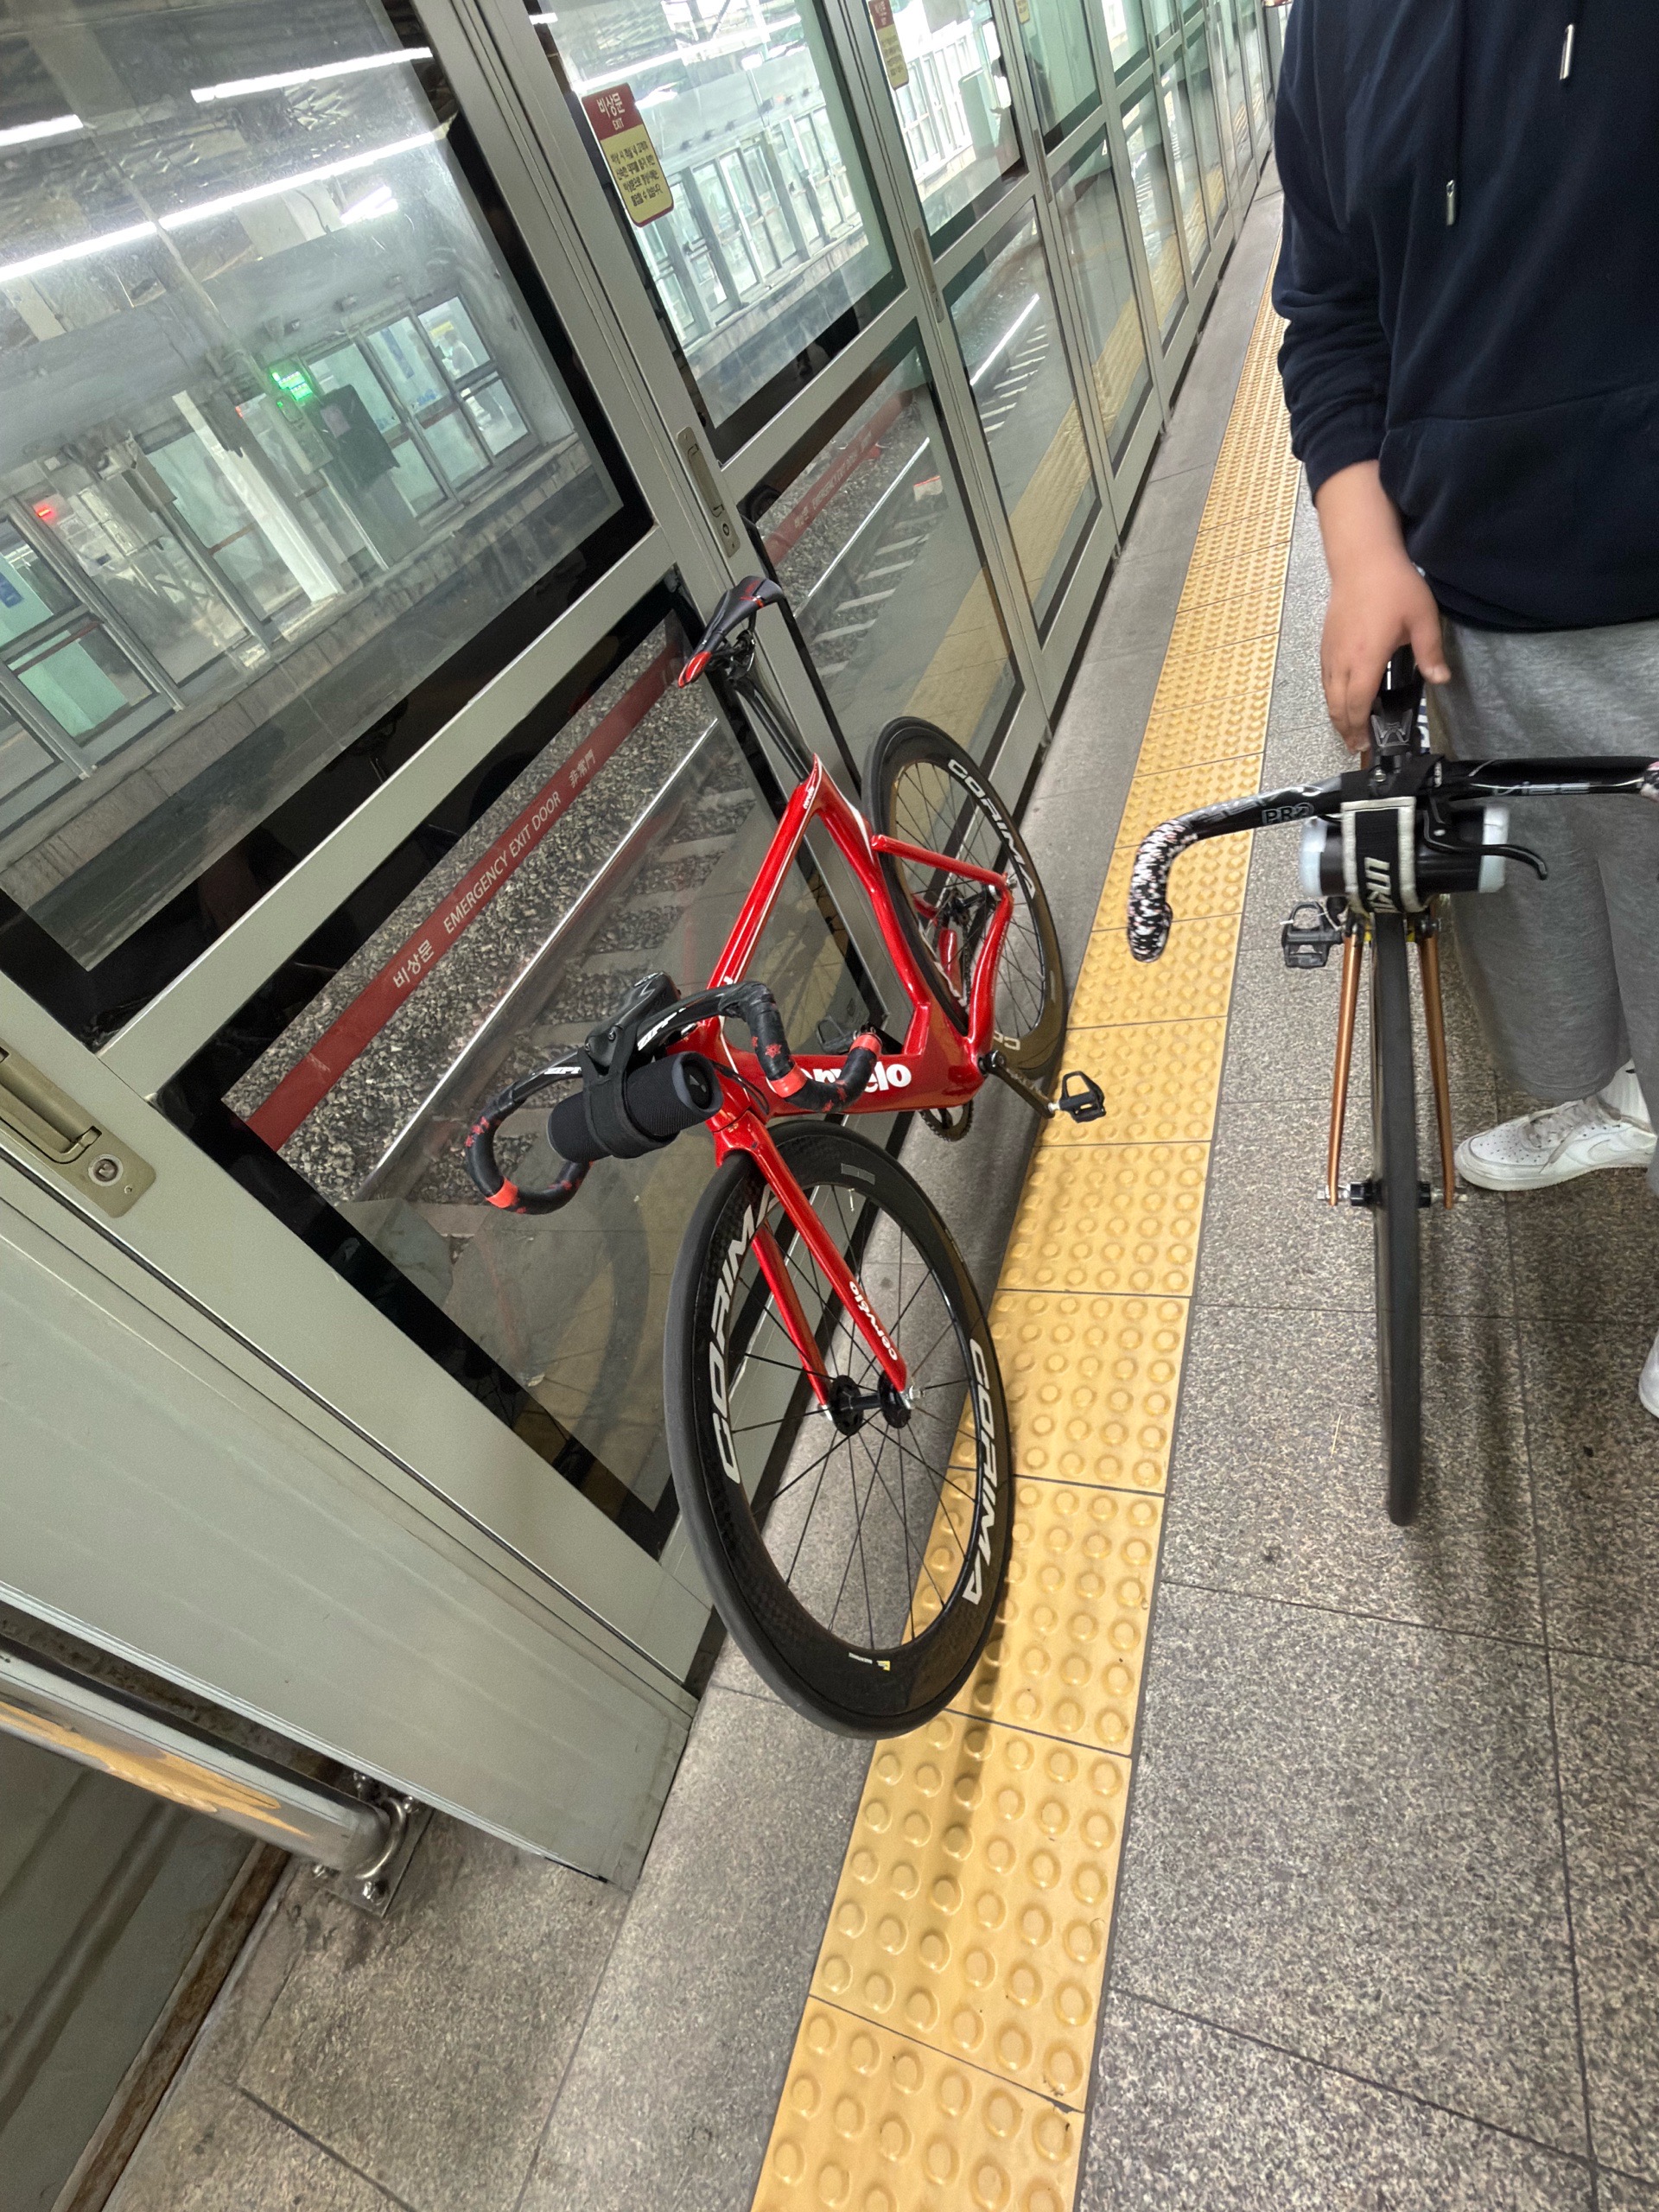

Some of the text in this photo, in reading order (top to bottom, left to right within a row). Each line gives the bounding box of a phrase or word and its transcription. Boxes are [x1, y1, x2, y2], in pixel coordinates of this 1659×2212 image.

[596, 92, 626, 118] 비상문
[393, 939, 435, 988] 비상문
[443, 850, 508, 934] EMERGENCY
[509, 824, 531, 858] EXIT
[531, 791, 562, 831] DOOR
[948, 759, 1036, 899] CORIMA
[849, 1281, 898, 1361] cervélo
[962, 1338, 998, 1605] CORIMA
